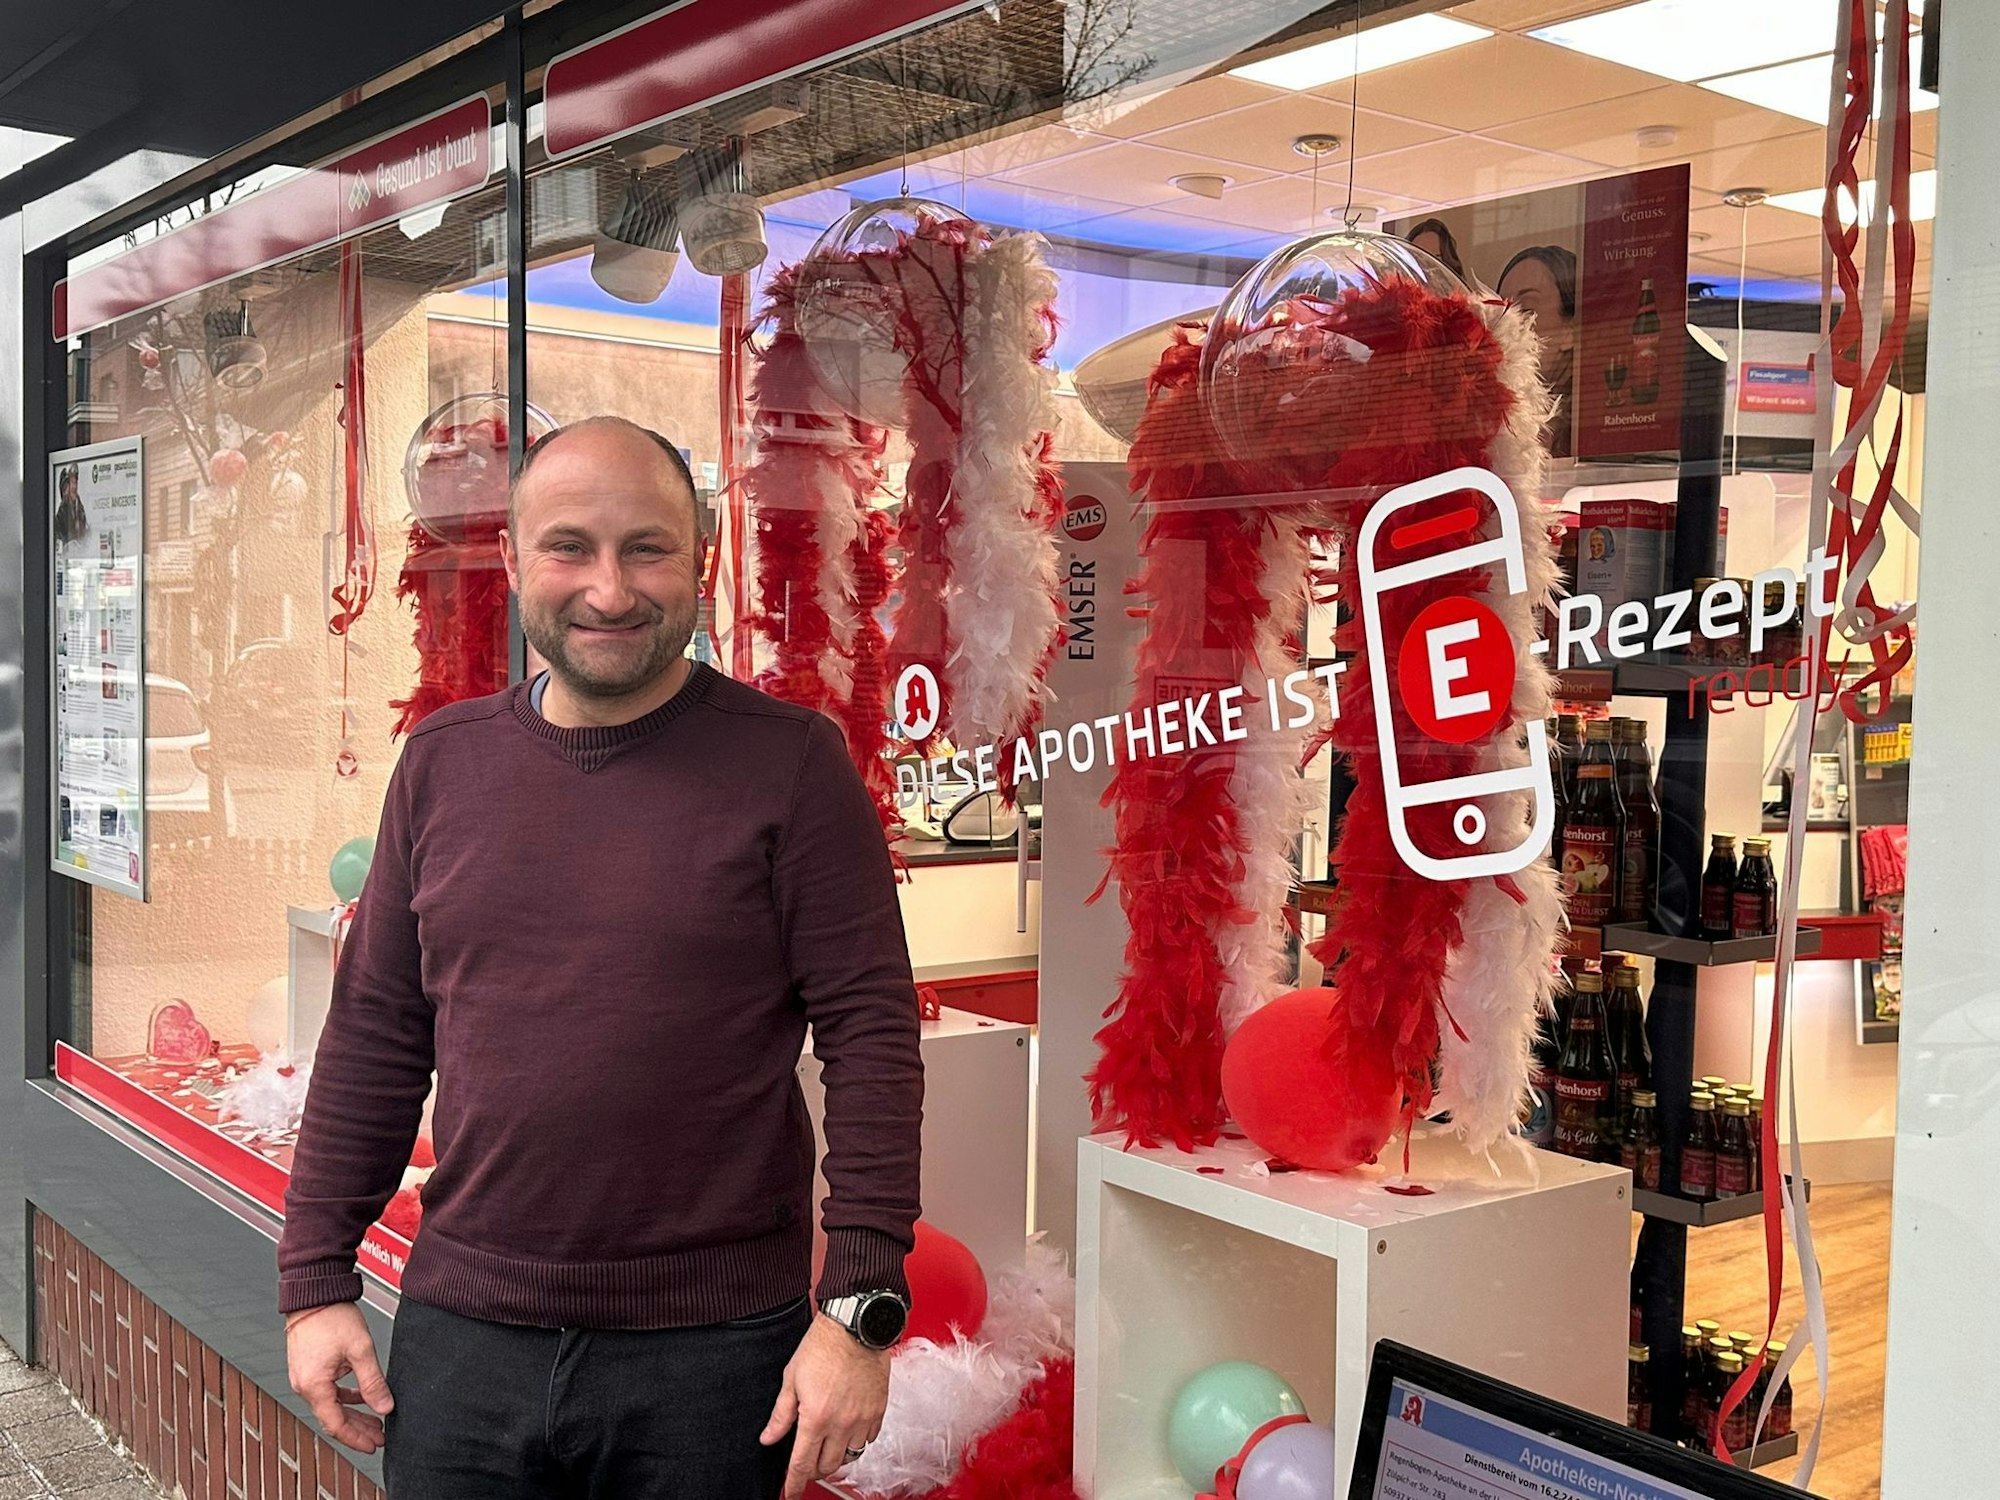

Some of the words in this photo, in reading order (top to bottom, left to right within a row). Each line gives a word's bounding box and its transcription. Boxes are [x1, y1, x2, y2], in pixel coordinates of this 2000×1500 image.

[376, 147, 421, 199] Gesund
[424, 141, 441, 180] ist
[445, 126, 477, 172] bunt
[1621, 207, 1666, 223] Genuss.
[1603, 246, 1656, 261] Wirkung.
[1604, 411, 1658, 426] Rabenhorst
[1066, 507, 1102, 528] EMS
[1688, 634, 1851, 719] ready
[896, 744, 998, 809] DIESE
[1012, 684, 1248, 786] APOTHEKE
[1267, 661, 1347, 731] IST
[1563, 828, 1607, 841] benhorst
[1556, 1079, 1601, 1097] benhorst
[1389, 1451, 1467, 1491] Regenbogen-Apotheke
[1468, 1485, 1478, 1494] an
[1479, 1489, 1492, 1500] der
[1464, 1453, 1517, 1482] Dienstbereit
[1518, 1477, 1538, 1492] vom
[1419, 1481, 1430, 1493] Str.
[1432, 1488, 1446, 1500] 283
